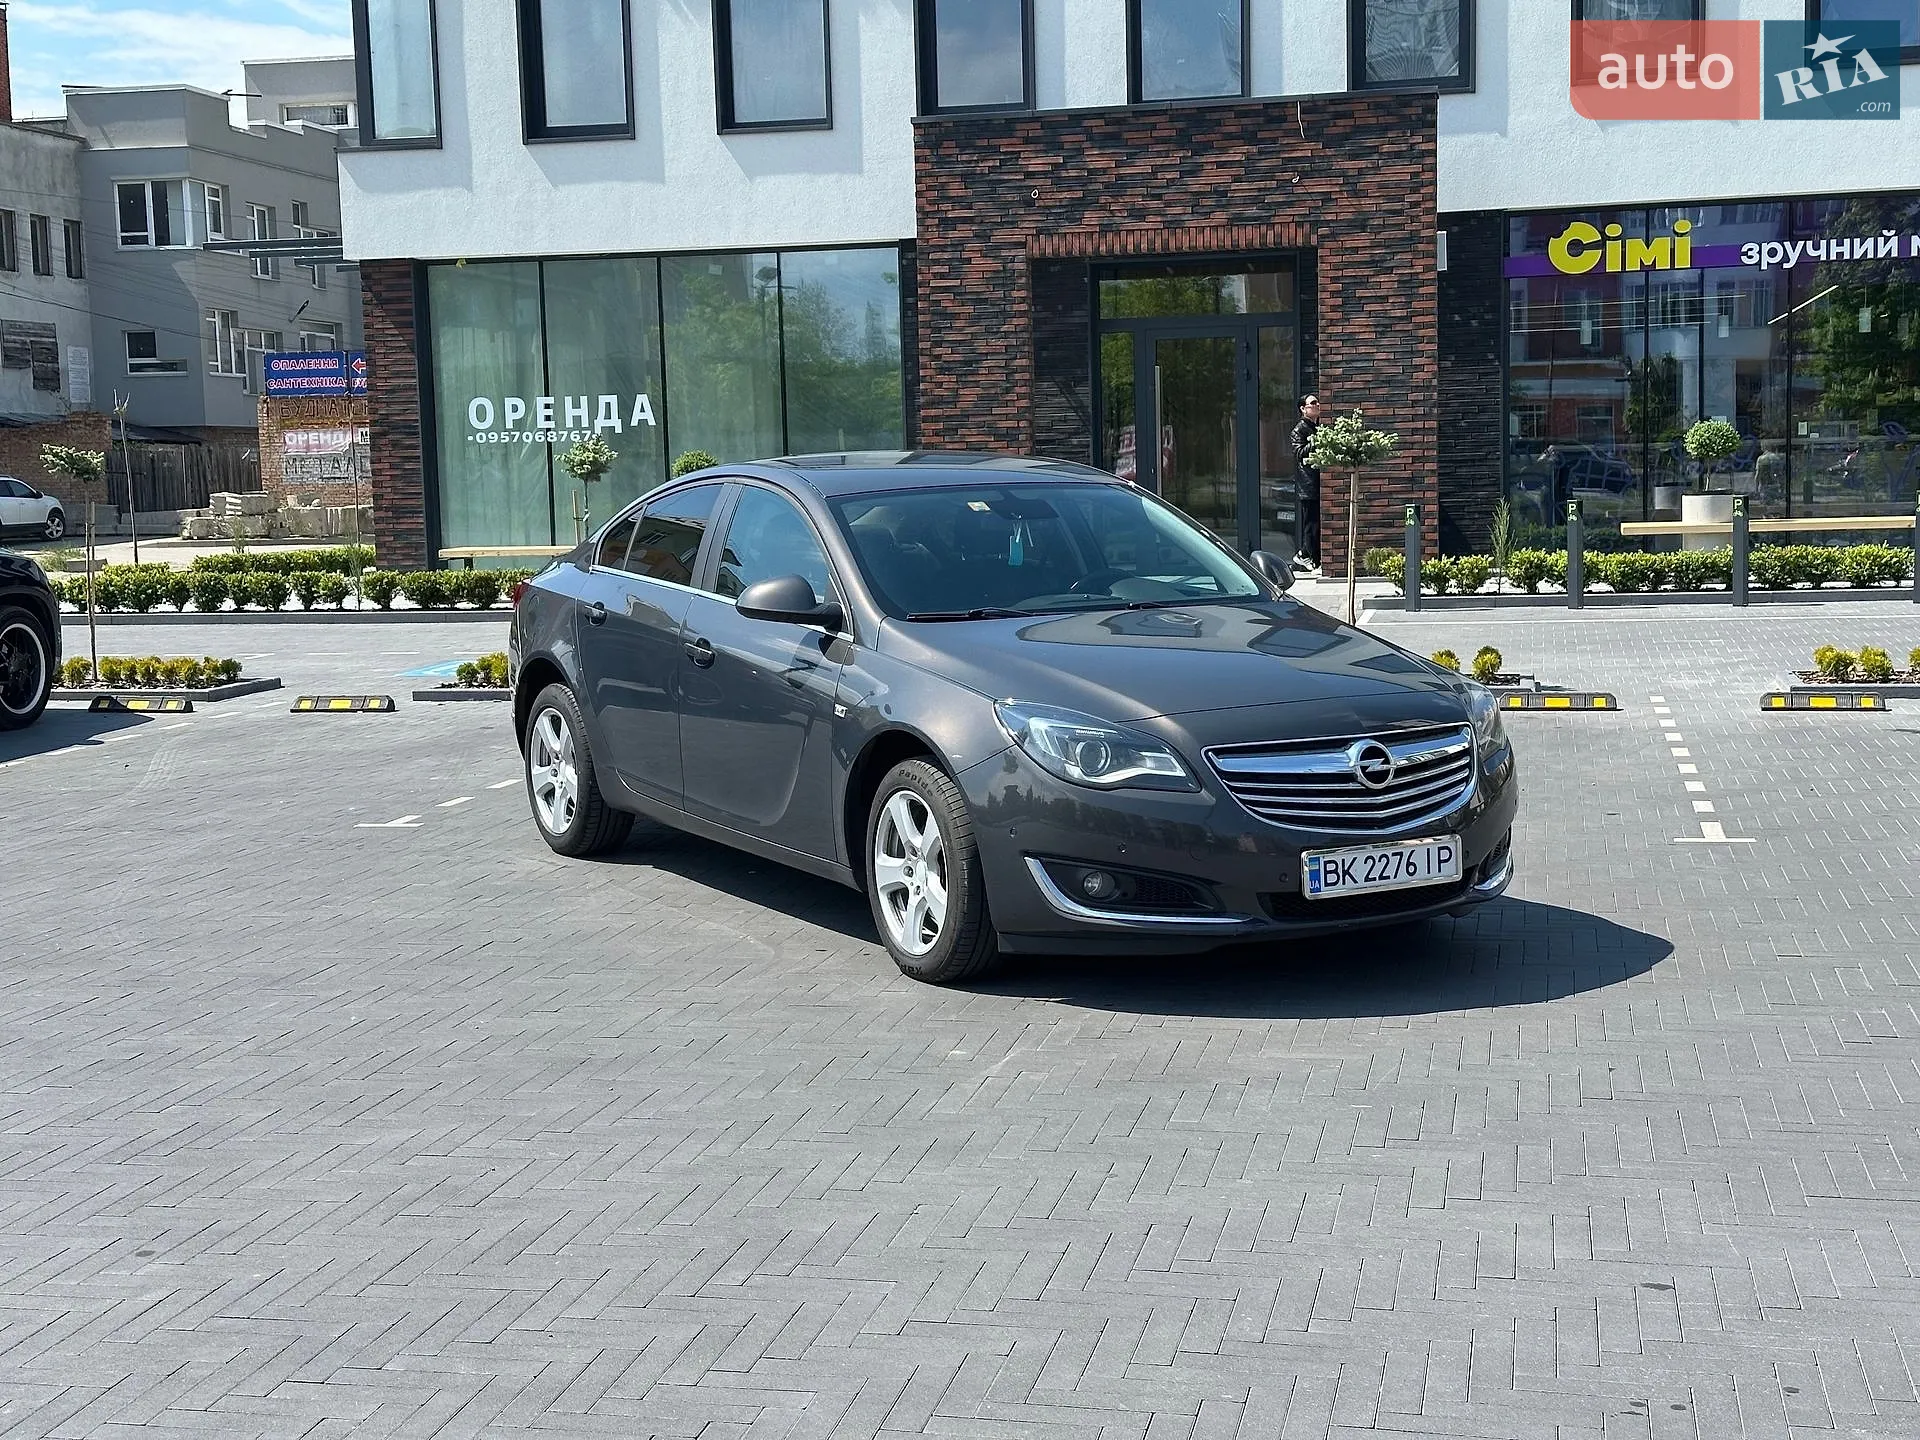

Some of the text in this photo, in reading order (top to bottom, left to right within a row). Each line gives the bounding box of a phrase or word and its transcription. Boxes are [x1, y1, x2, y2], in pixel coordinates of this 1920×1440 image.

[1548, 220, 1691, 274] Сімі
[1740, 229, 1899, 270] зручний
[271, 358, 338, 370] ОПАЛЕННЯ
[267, 377, 345, 389] САНТЕХНІКА
[468, 394, 656, 433] ОРЕНДА
[1568, 503, 1576, 514] P
[1734, 498, 1743, 509] P
[1406, 507, 1415, 518] P
[1323, 845, 1453, 887] BK 2276 IP
[1309, 879, 1320, 889] UA
